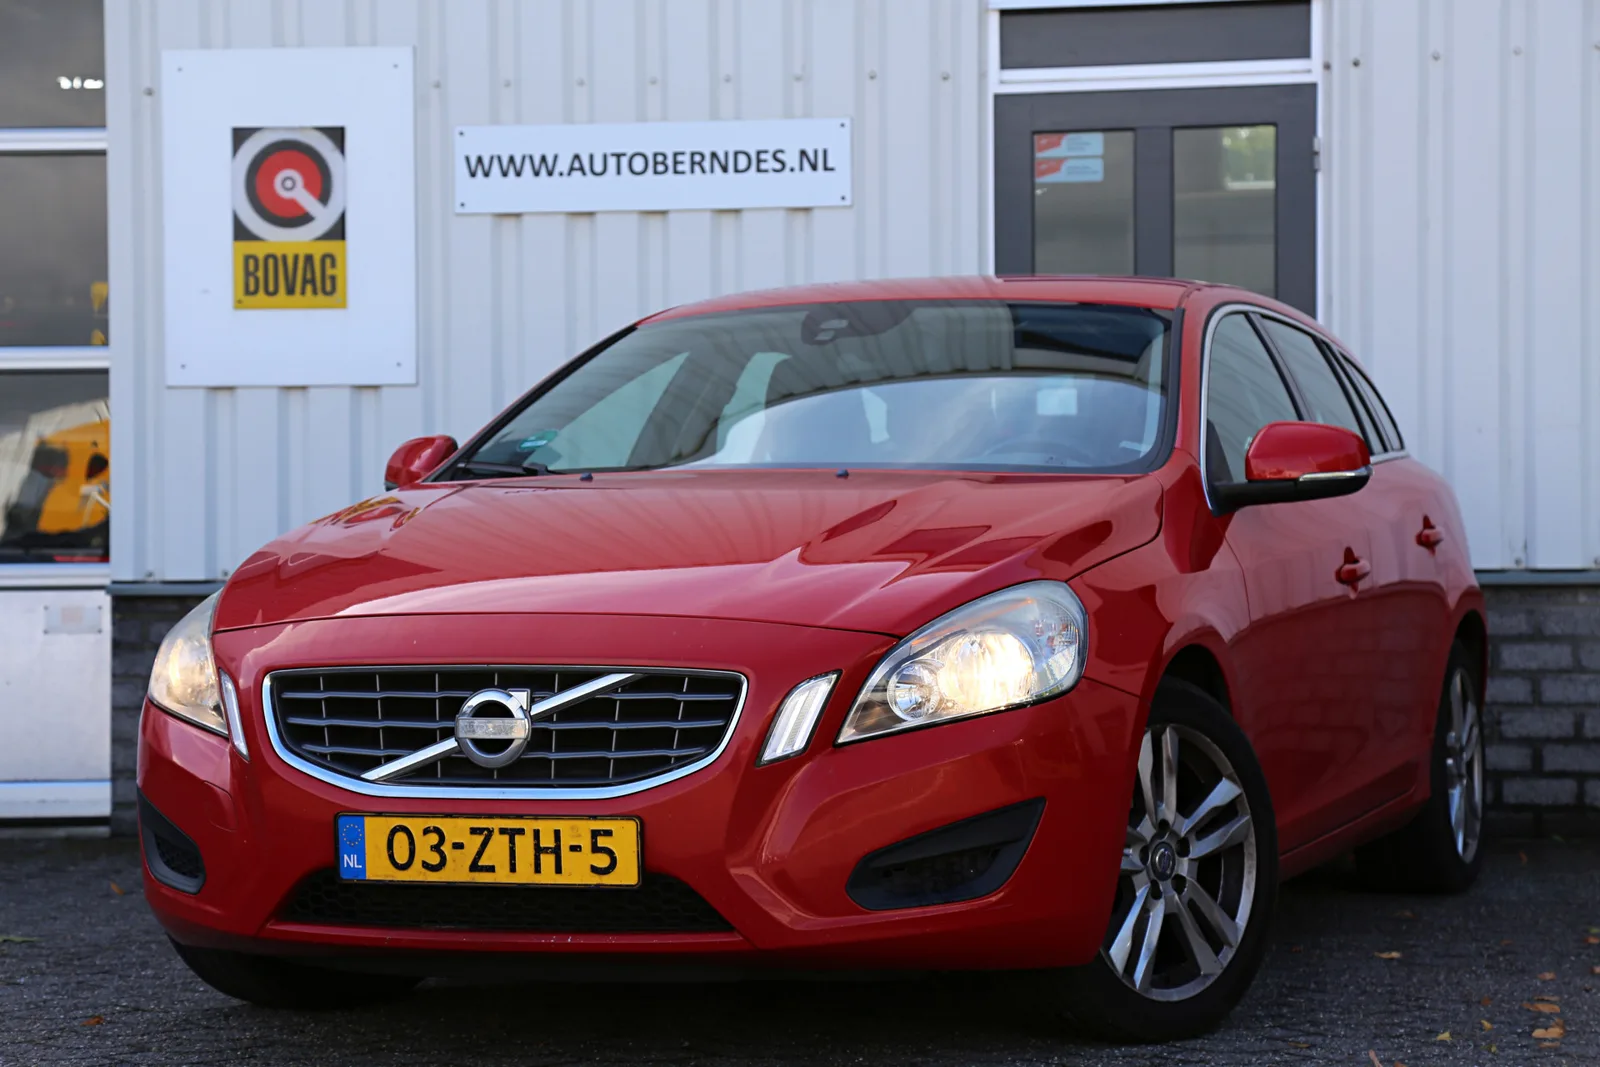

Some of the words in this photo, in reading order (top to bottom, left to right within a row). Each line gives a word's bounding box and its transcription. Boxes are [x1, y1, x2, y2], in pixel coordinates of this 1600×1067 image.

[465, 148, 836, 178] WWW.AUTOBERNDES.NL
[243, 252, 337, 297] BOVAG
[343, 854, 362, 869] NL
[386, 824, 618, 876] 03-ZTH-5
